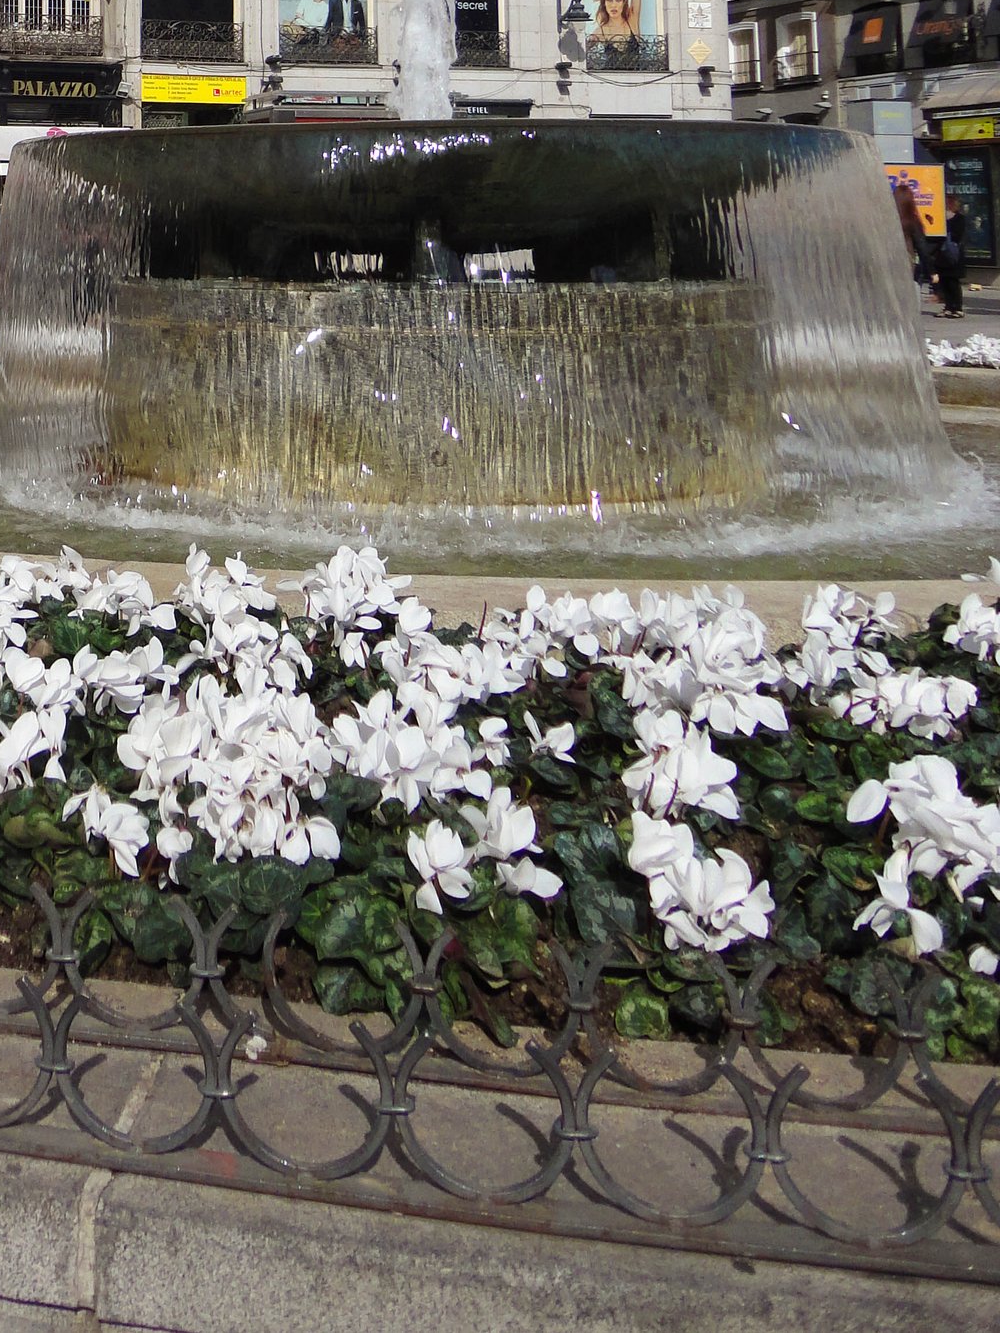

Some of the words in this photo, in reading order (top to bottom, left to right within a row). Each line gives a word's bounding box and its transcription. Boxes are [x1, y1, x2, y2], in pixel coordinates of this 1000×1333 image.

[455, 0, 488, 11] 'secret
[12, 80, 97, 98] PALAZZO
[467, 107, 489, 115] EFIEL
